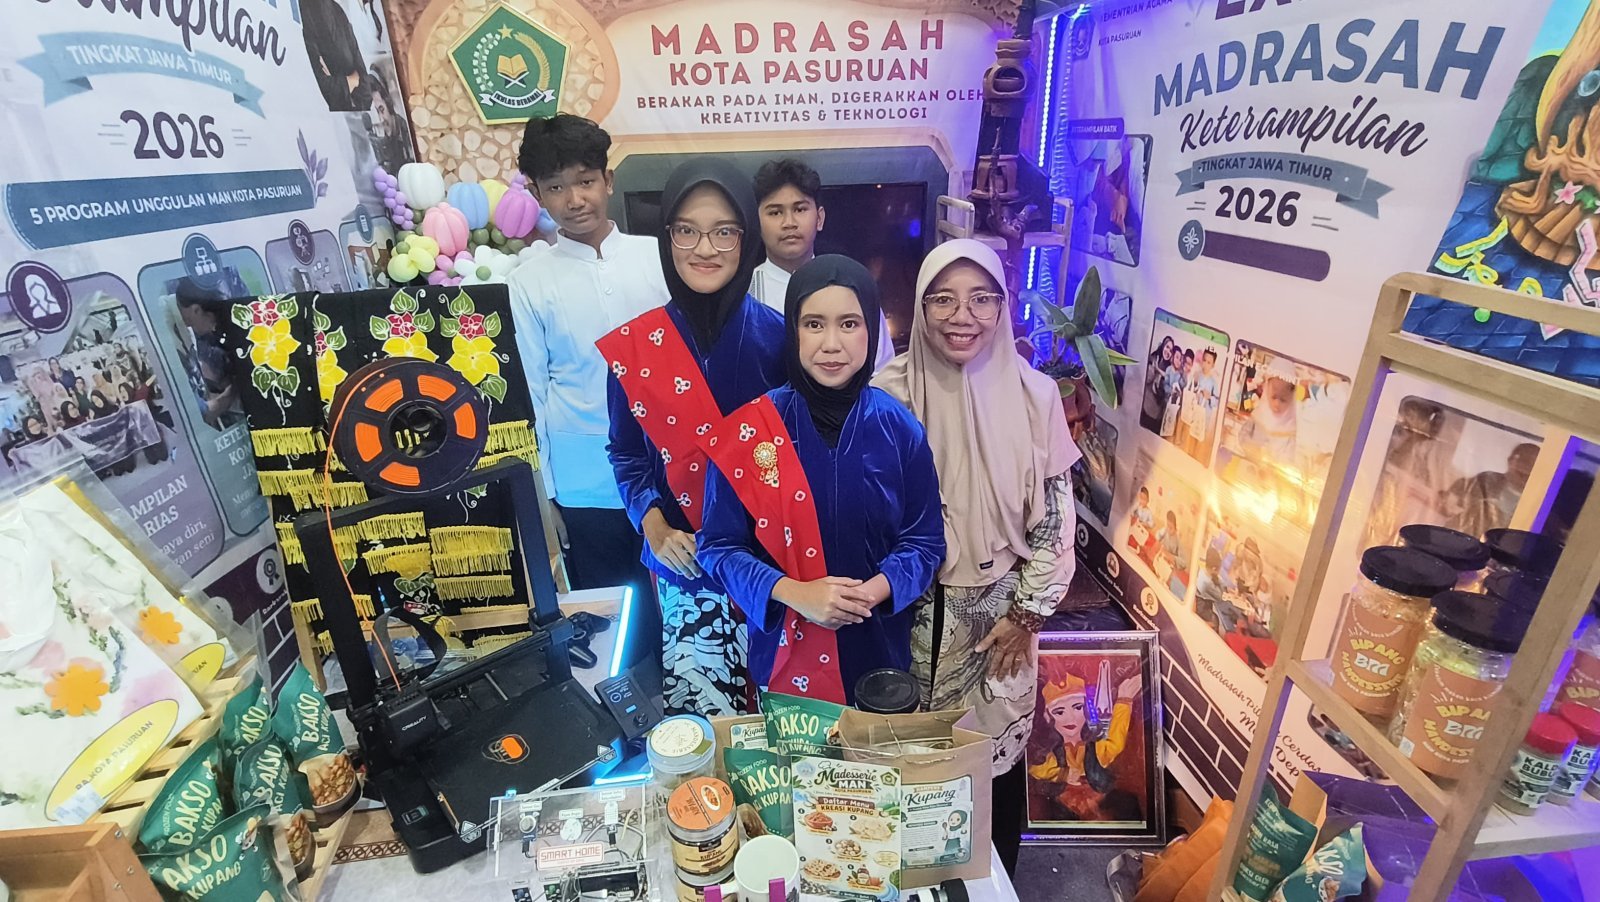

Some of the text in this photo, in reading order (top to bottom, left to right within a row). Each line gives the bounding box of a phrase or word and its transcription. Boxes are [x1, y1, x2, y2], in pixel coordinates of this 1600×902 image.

[651, 20, 944, 55] MADRASAH
[1110, 29, 1141, 44] PASURUAN
[66, 45, 232, 84] TINGKAT JAWA TIMUR
[669, 58, 928, 86] KOTA PASURUAN
[1154, 18, 1506, 116] MADRASAH
[637, 89, 984, 109] BERAKAR PADA IMAN, DIGERAKKAN OLEH
[700, 107, 927, 125] KREATIVITAS & TEKNOLOGI
[1179, 95, 1428, 157] Keterampilan
[120, 110, 225, 159] 2026
[1201, 157, 1333, 182] TINGKAT JAWA TIMUR
[30, 184, 302, 225] 5 PROGRAM UNGGULAN MAN KOTA PASURUAN
[1215, 185, 1301, 227] 2026
[130, 475, 188, 520] MPILAN
[143, 505, 179, 538] RIAS
[1565, 686, 1600, 699] BIP
[298, 693, 321, 743] BAKSO
[774, 713, 819, 739] BAKSO
[740, 765, 791, 797] BAKSO
[814, 767, 877, 786] Madesserie
[838, 780, 867, 789] MAN
[820, 804, 874, 816] KREASI KUPANG
[823, 797, 870, 808] Daftar Menu
[904, 788, 956, 806] Kupang
[168, 780, 212, 846] BAKSO
[162, 834, 227, 892] AKSO
[540, 845, 601, 861] SMART HOME
